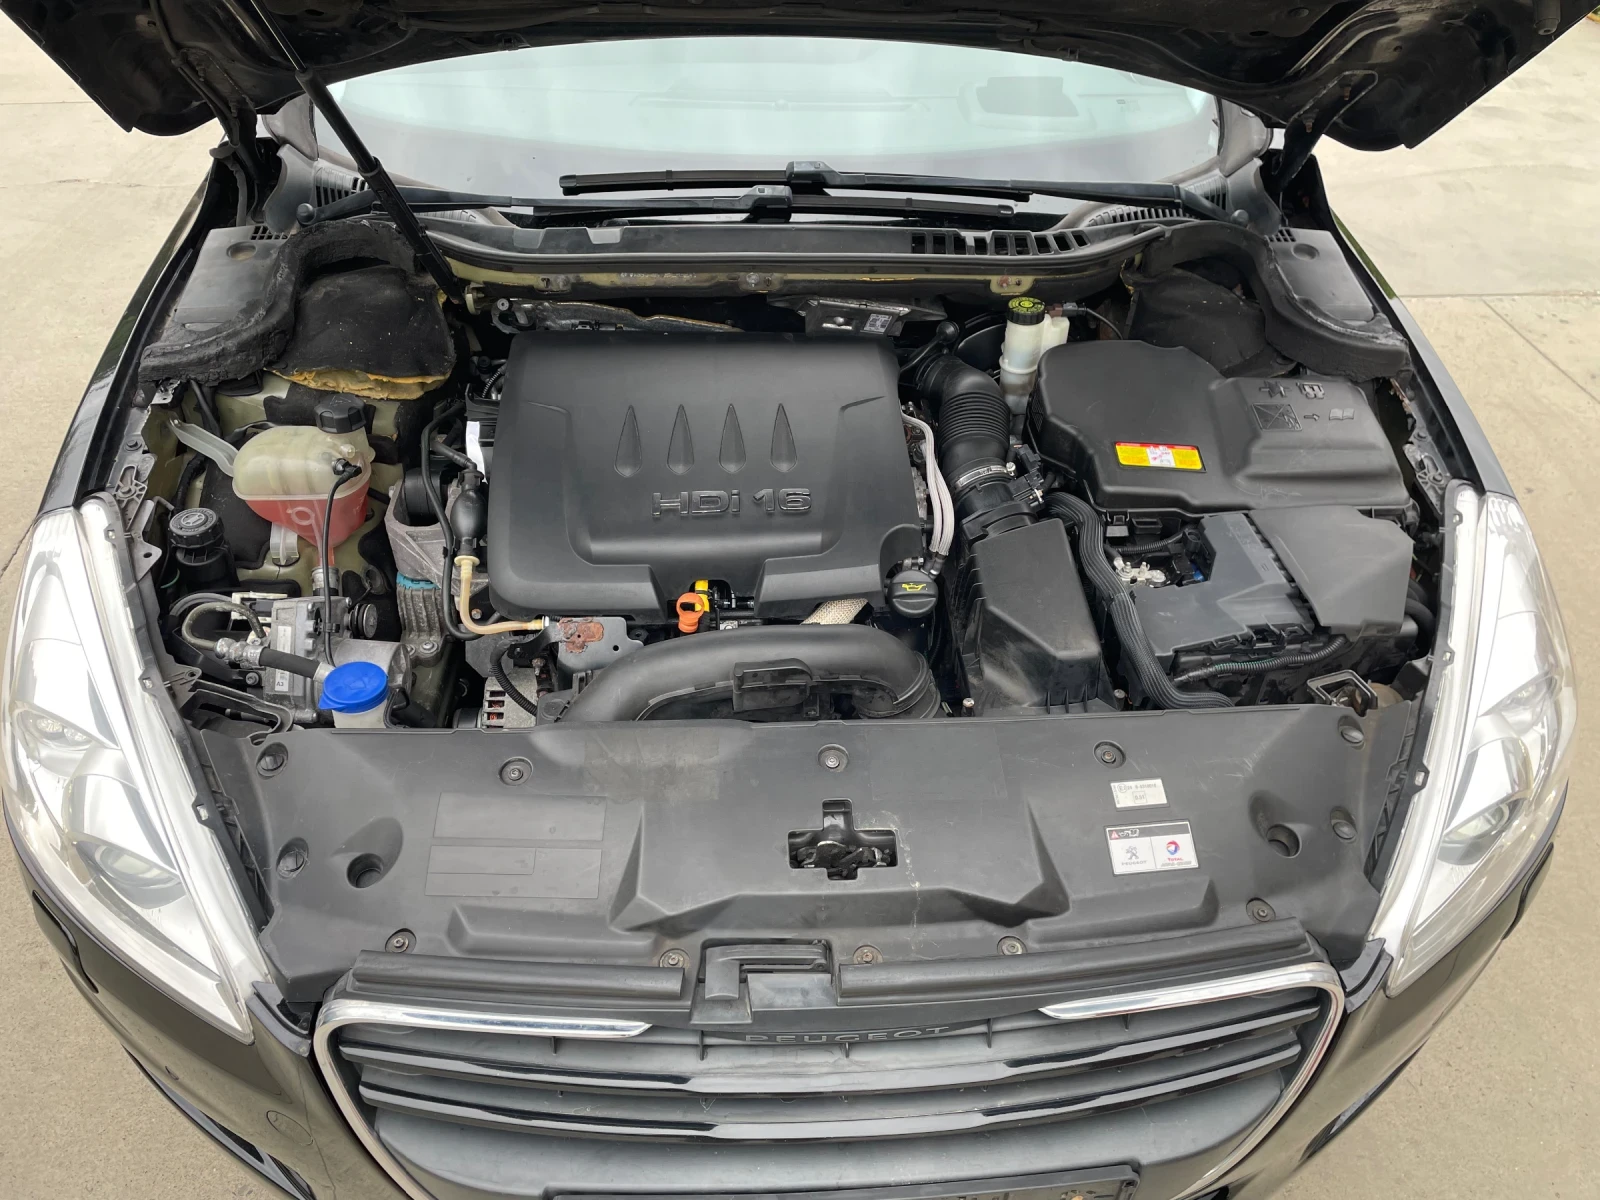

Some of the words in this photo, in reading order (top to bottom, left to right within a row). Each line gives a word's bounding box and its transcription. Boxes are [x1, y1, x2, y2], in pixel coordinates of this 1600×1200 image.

[652, 489, 740, 516] HDi
[753, 488, 812, 513] 16
[745, 1026, 950, 1043] PEUGEOT
